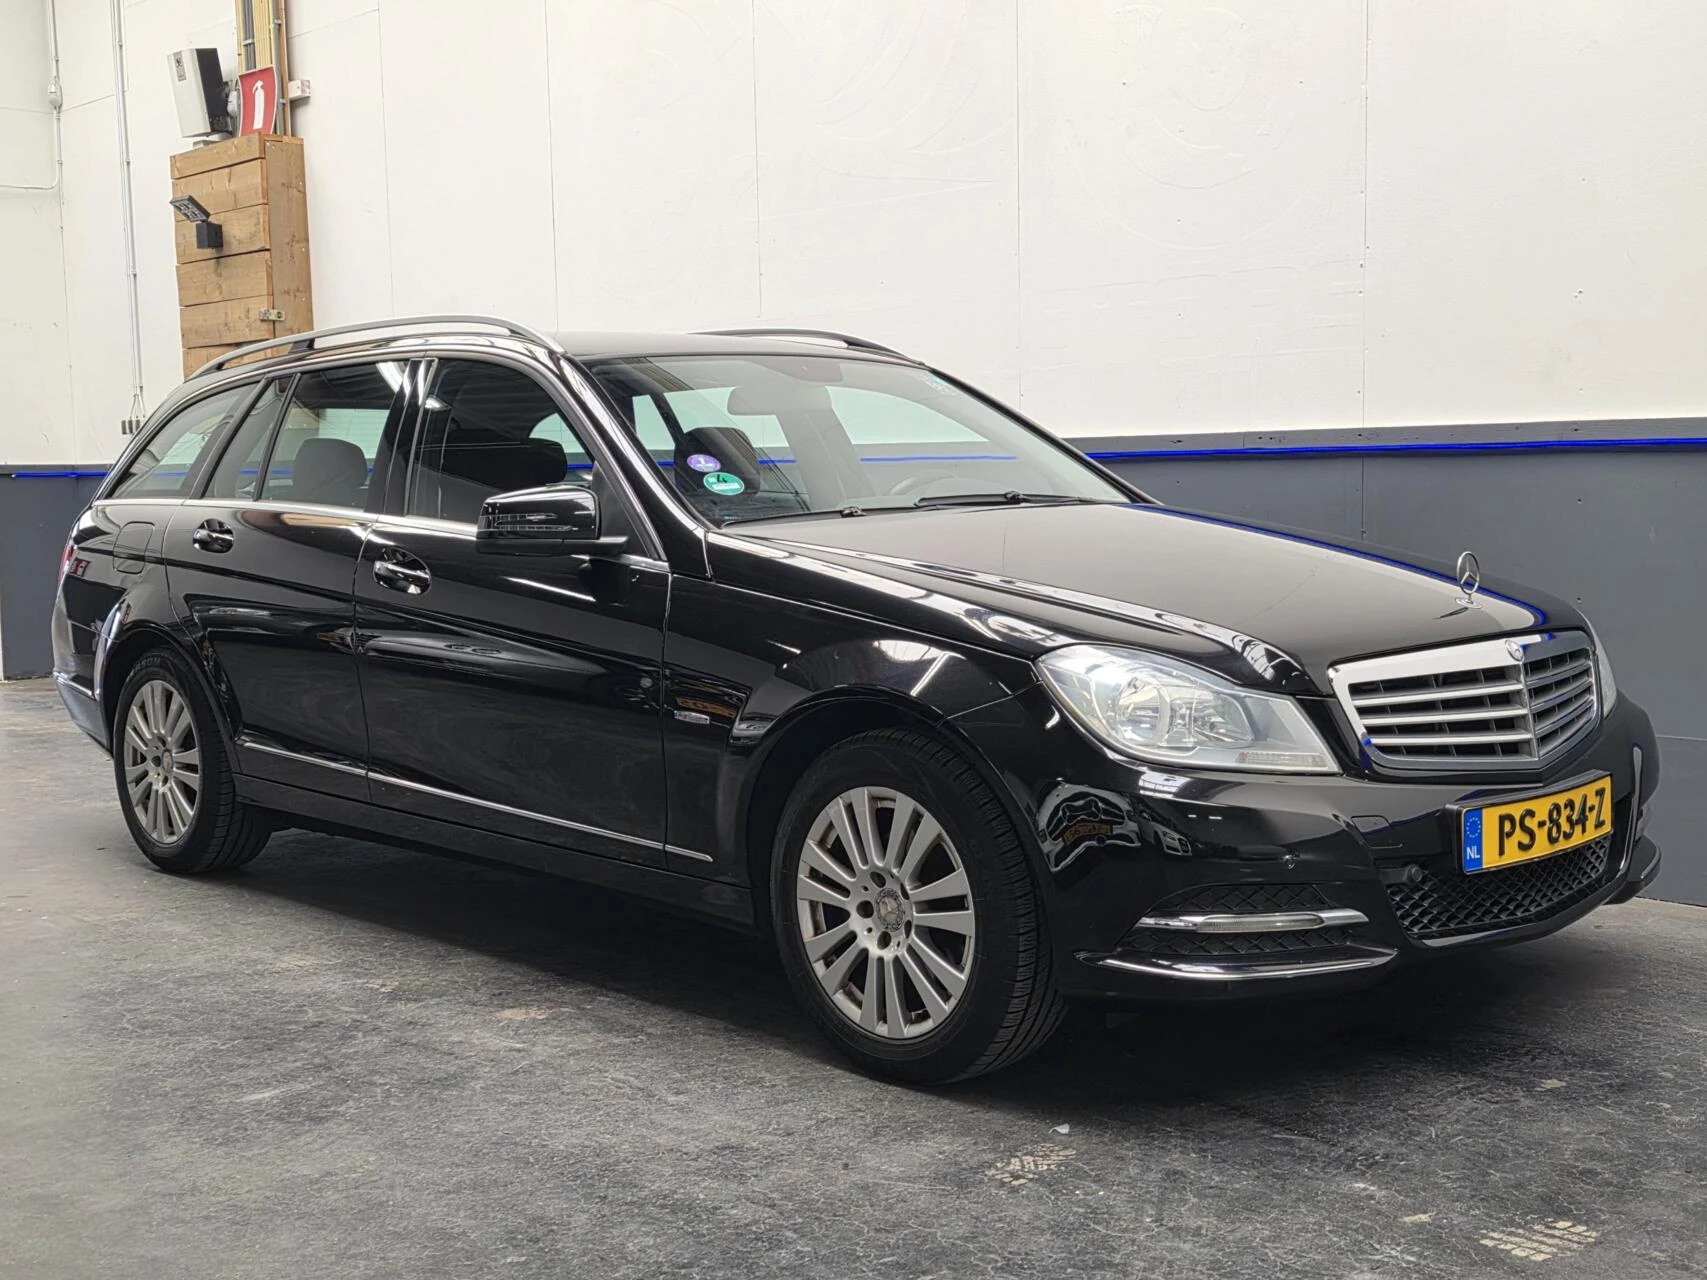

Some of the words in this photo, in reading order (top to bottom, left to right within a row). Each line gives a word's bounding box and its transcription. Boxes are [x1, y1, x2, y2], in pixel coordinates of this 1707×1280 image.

[716, 473, 728, 484] 4
[1498, 786, 1606, 858] PS-834-Z
[1466, 845, 1481, 860] NL
